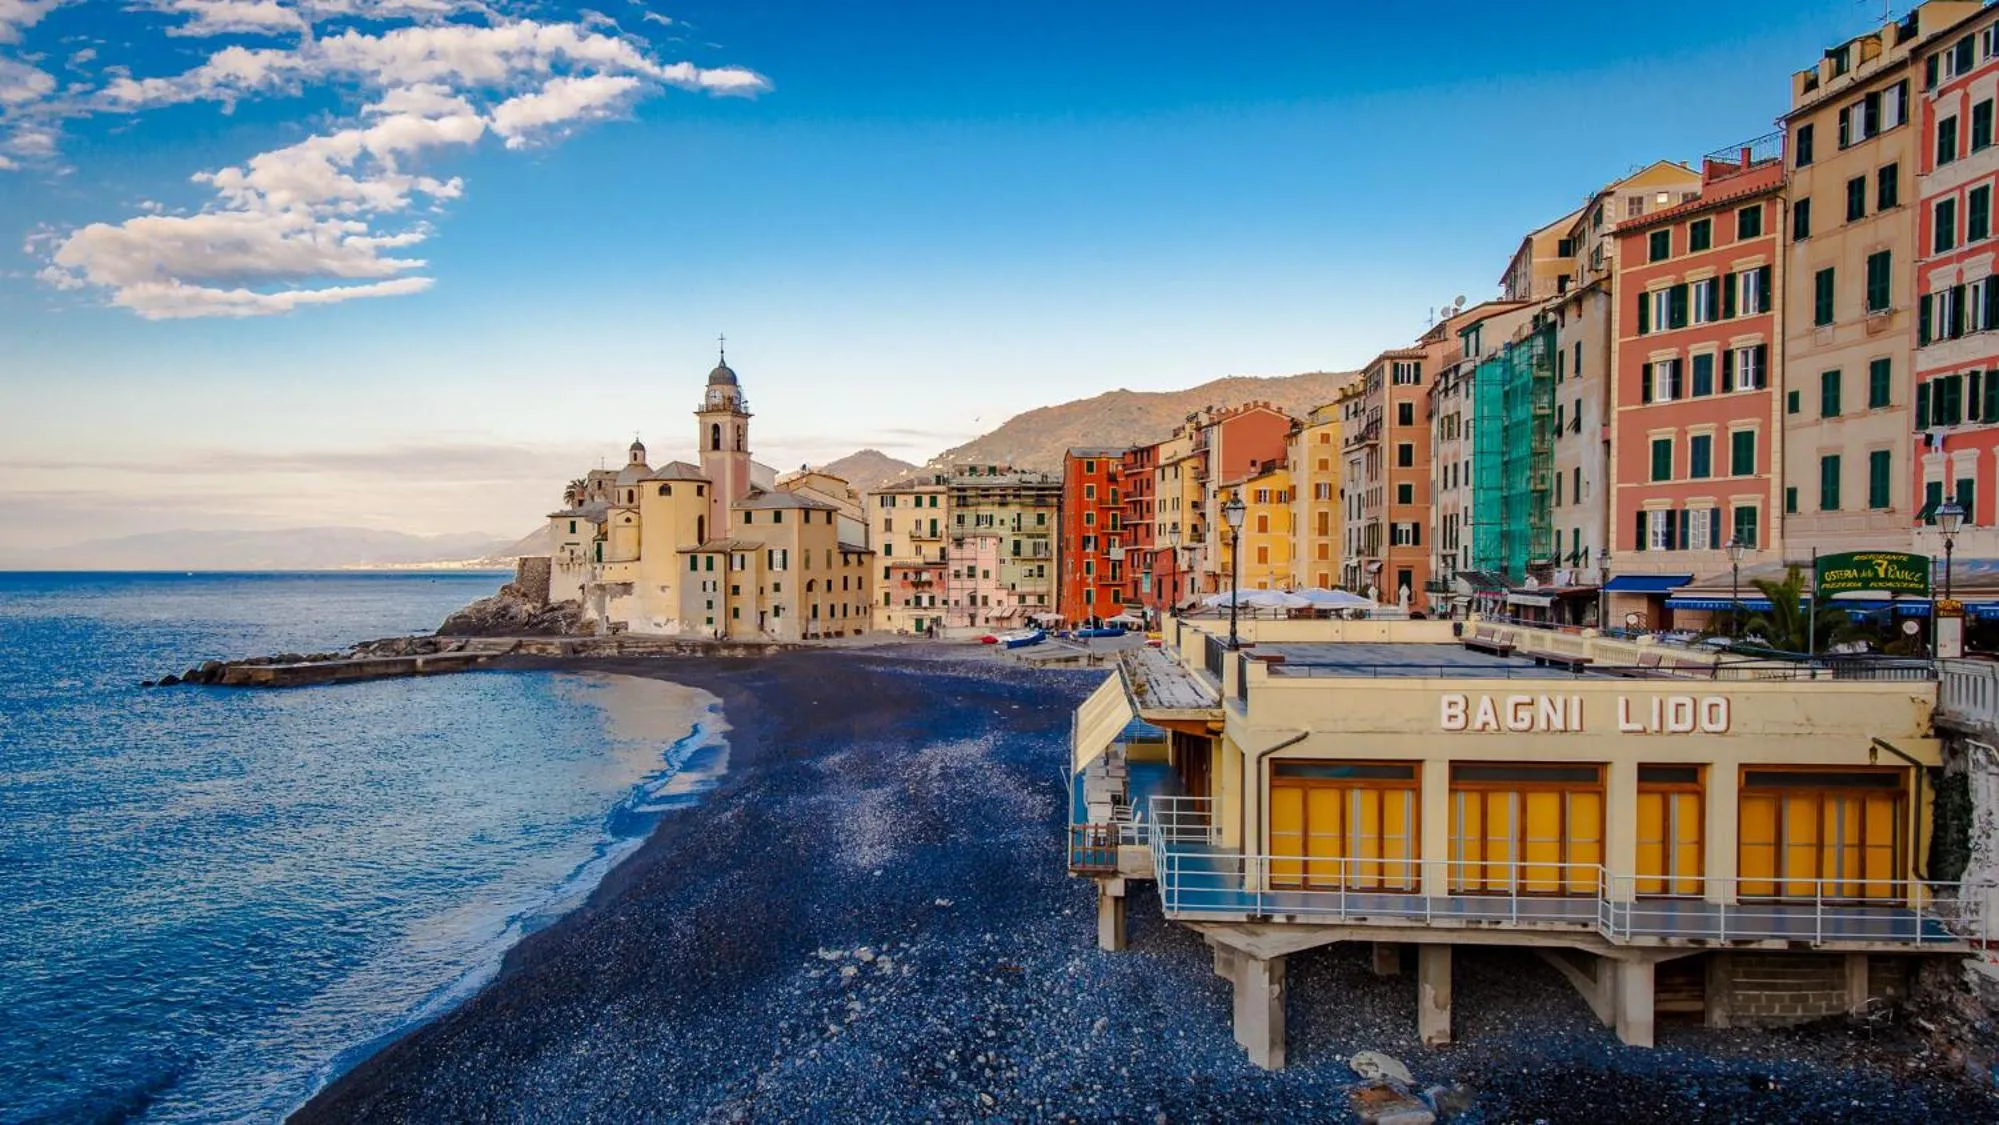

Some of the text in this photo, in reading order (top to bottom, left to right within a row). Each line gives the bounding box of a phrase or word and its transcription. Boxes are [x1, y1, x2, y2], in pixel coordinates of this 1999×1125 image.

[1872, 560, 1888, 578] 7
[1440, 694, 1730, 733] BAGNI LIDO
